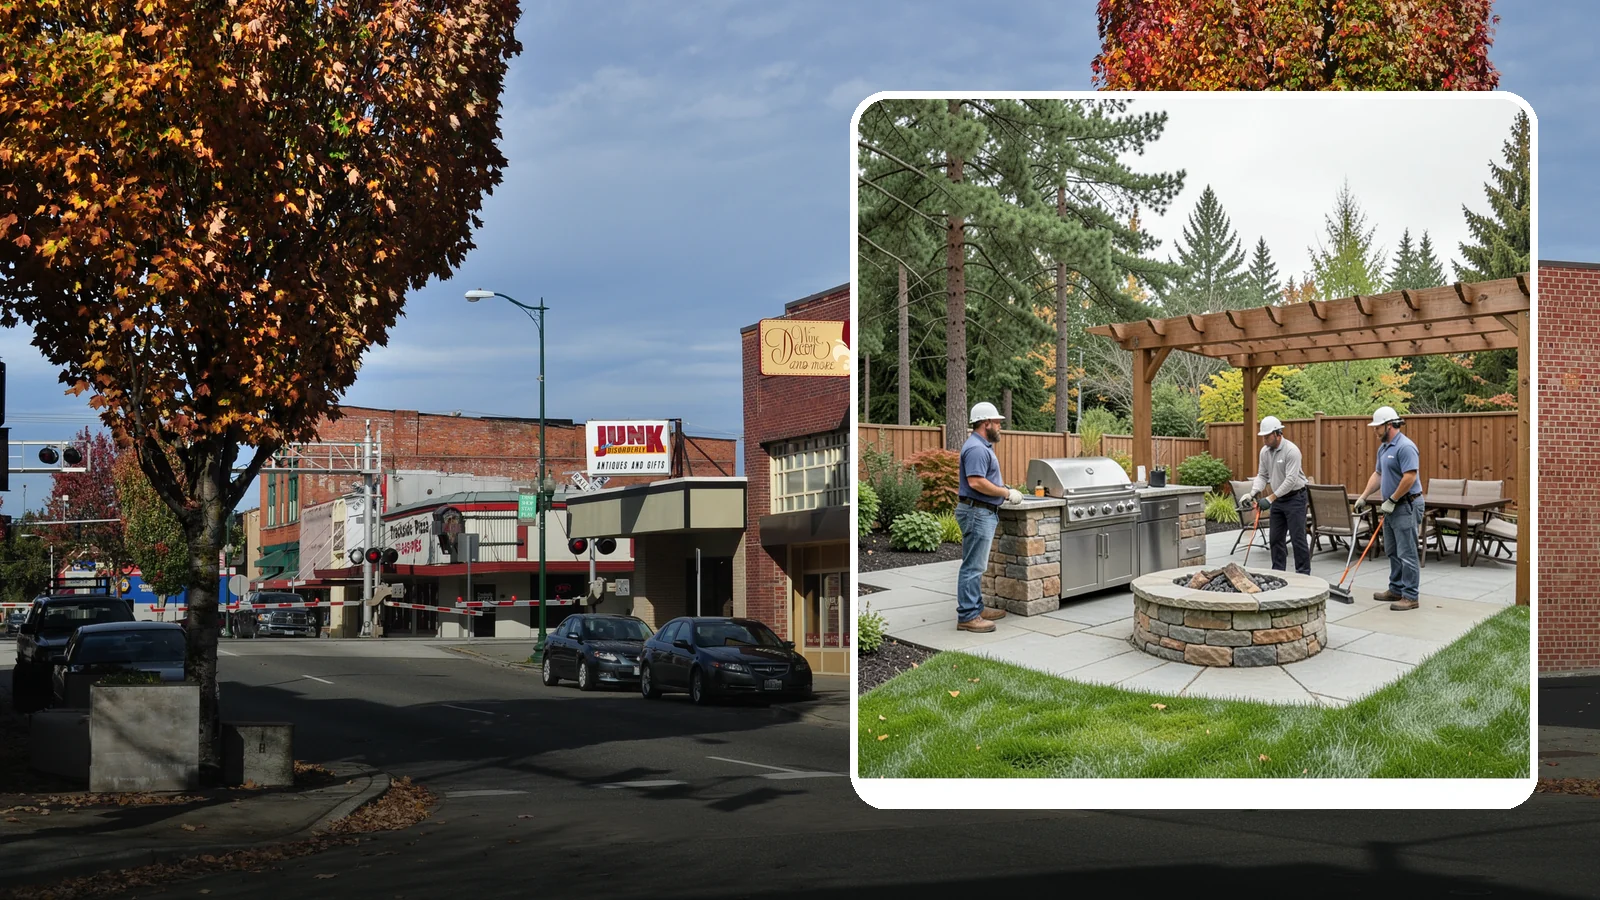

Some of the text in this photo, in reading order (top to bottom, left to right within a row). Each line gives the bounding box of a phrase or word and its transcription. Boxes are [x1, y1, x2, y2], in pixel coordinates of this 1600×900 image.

[595, 425, 665, 457] JUNK
[607, 446, 646, 454] DISORDERLY
[597, 460, 665, 470] ANTIQUES AND GIFTS
